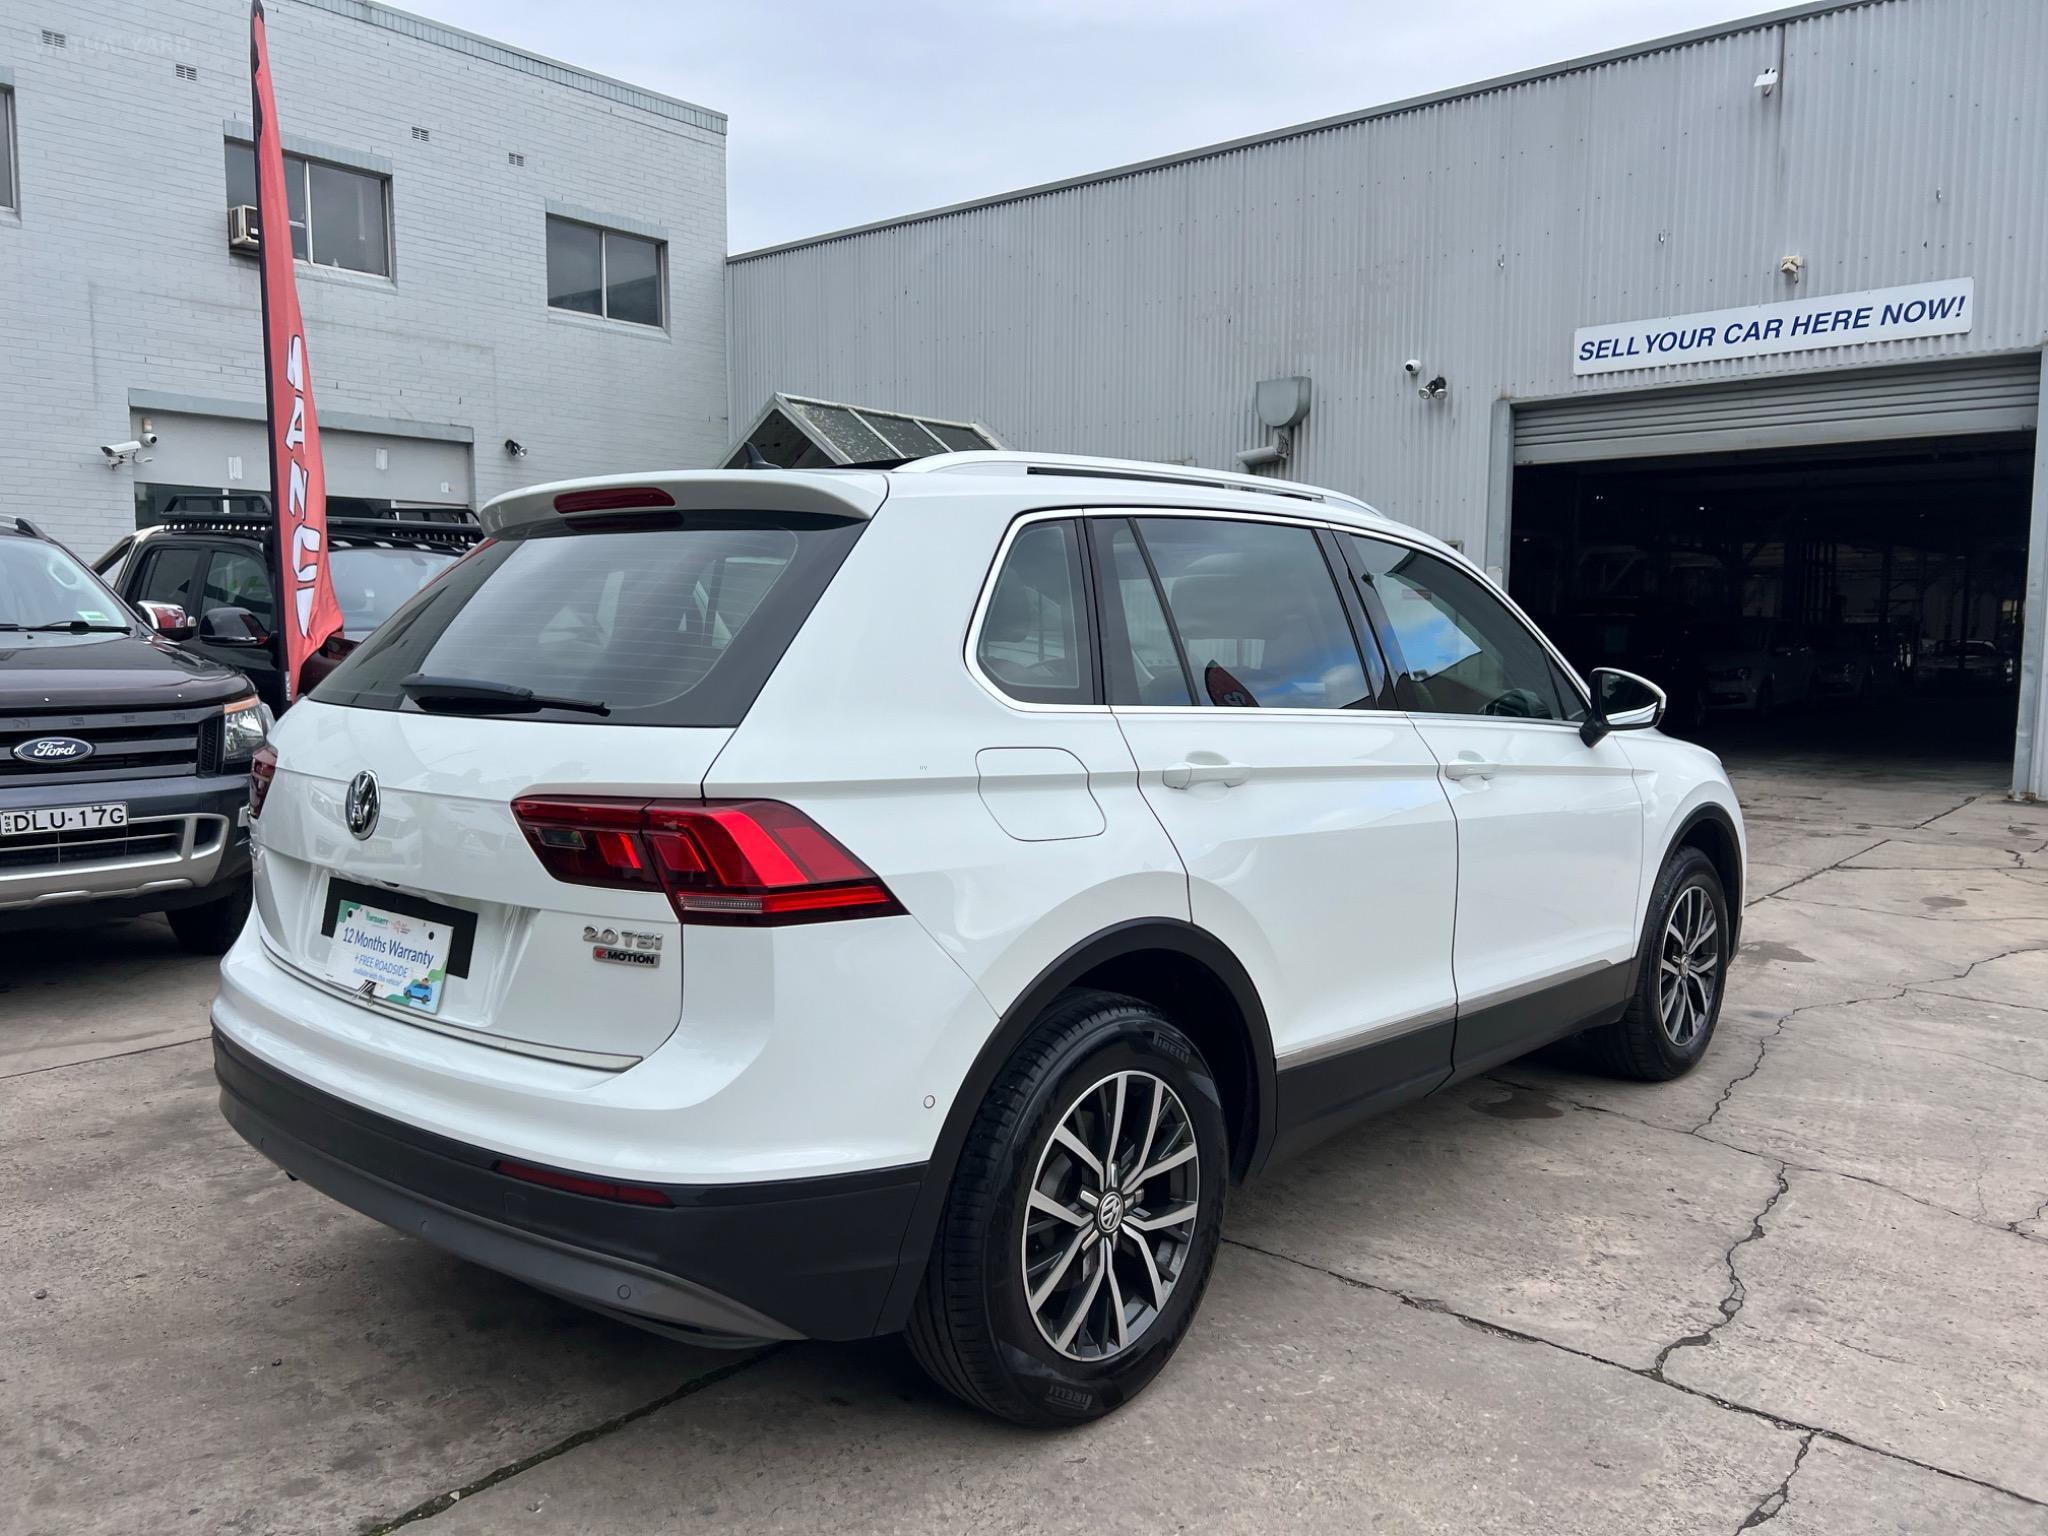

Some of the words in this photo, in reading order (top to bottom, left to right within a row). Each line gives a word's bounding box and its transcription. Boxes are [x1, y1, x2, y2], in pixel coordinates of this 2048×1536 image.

[1579, 337, 1639, 361] SELL
[1645, 327, 1716, 353] YOUR
[1724, 318, 1784, 344] CAR
[1790, 306, 1874, 336] HERE
[1880, 295, 1966, 326] NOW!
[34, 741, 77, 757] Ford
[343, 927, 354, 943] 12
[354, 930, 387, 953] Months
[389, 939, 434, 969] Warranty
[359, 956, 376, 969] FREE
[375, 959, 409, 978] ROADSIDE
[1152, 1030, 1191, 1065] PIRELLI
